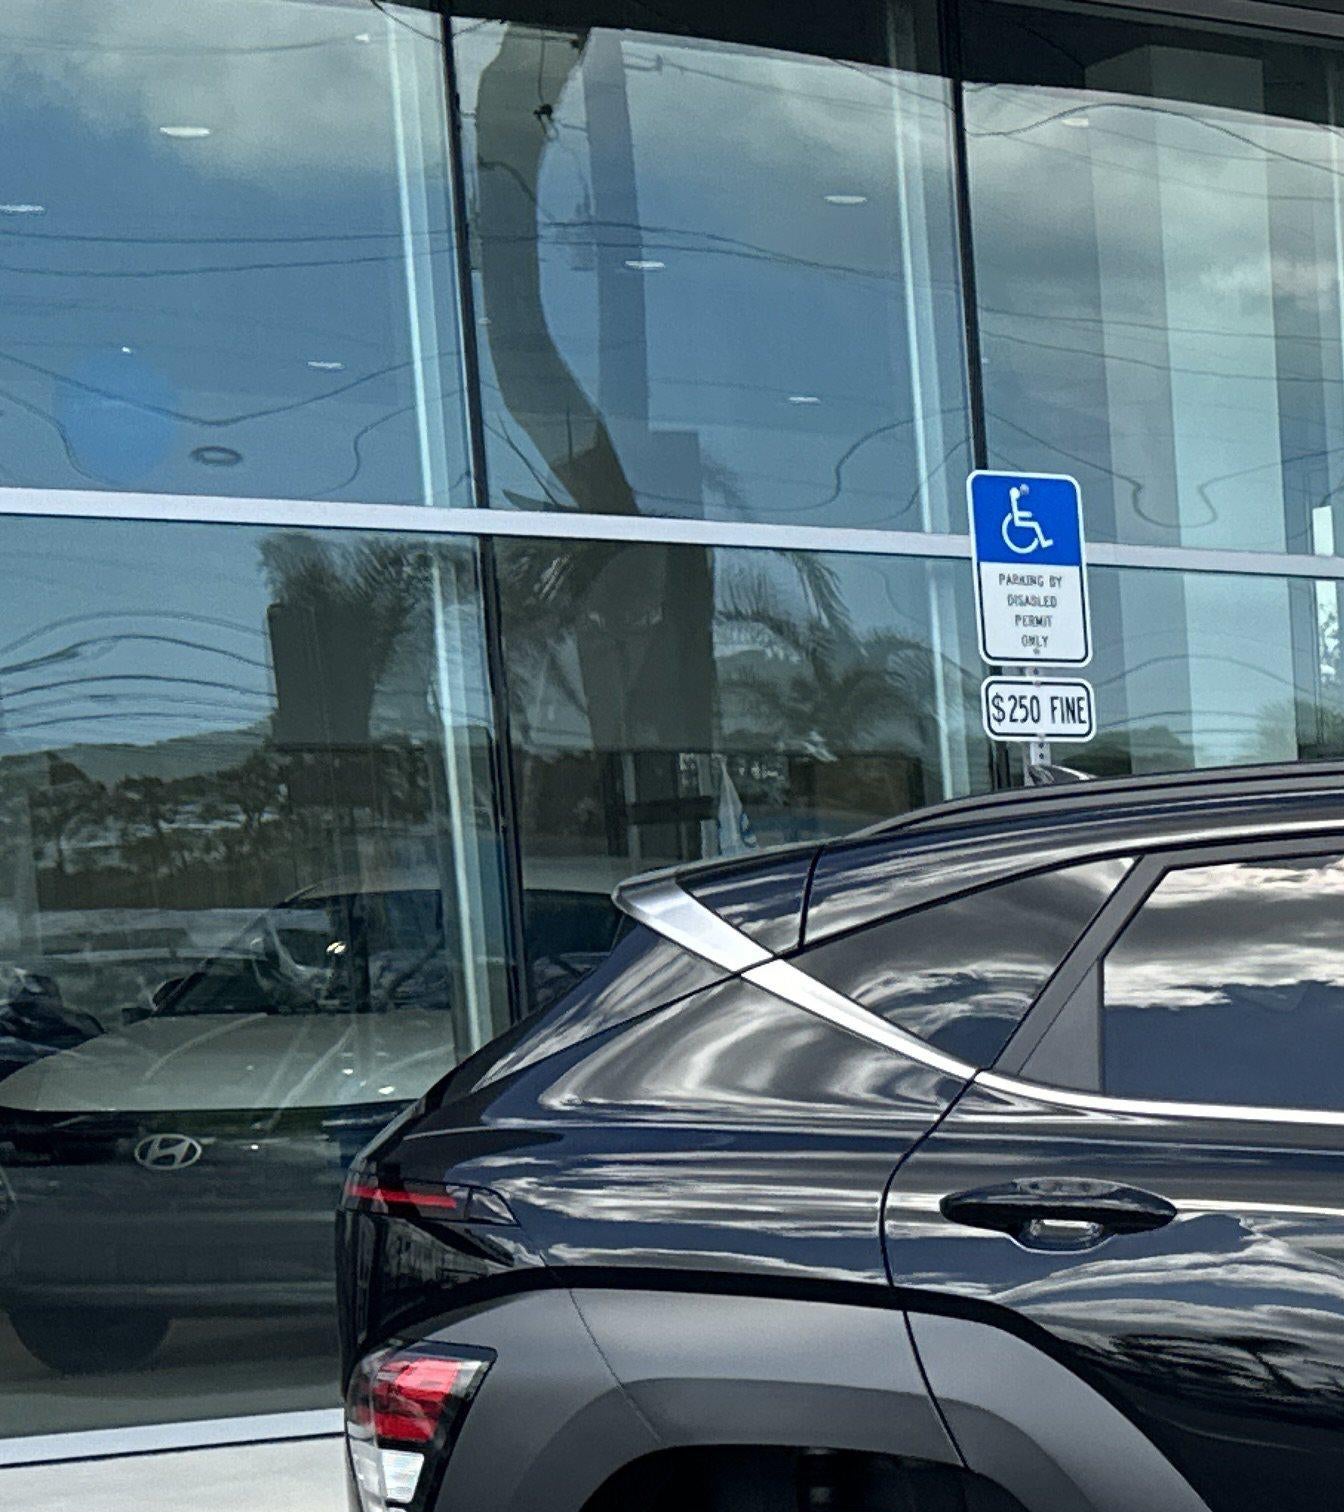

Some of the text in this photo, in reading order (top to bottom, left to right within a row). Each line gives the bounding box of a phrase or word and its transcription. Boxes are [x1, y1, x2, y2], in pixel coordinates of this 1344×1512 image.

[998, 573, 1062, 589] PARKING BY
[1007, 594, 1057, 608] DISABLED
[1014, 614, 1052, 628] PERMIT
[1021, 634, 1049, 648] ONLY
[991, 692, 1087, 727] $250 FINE
